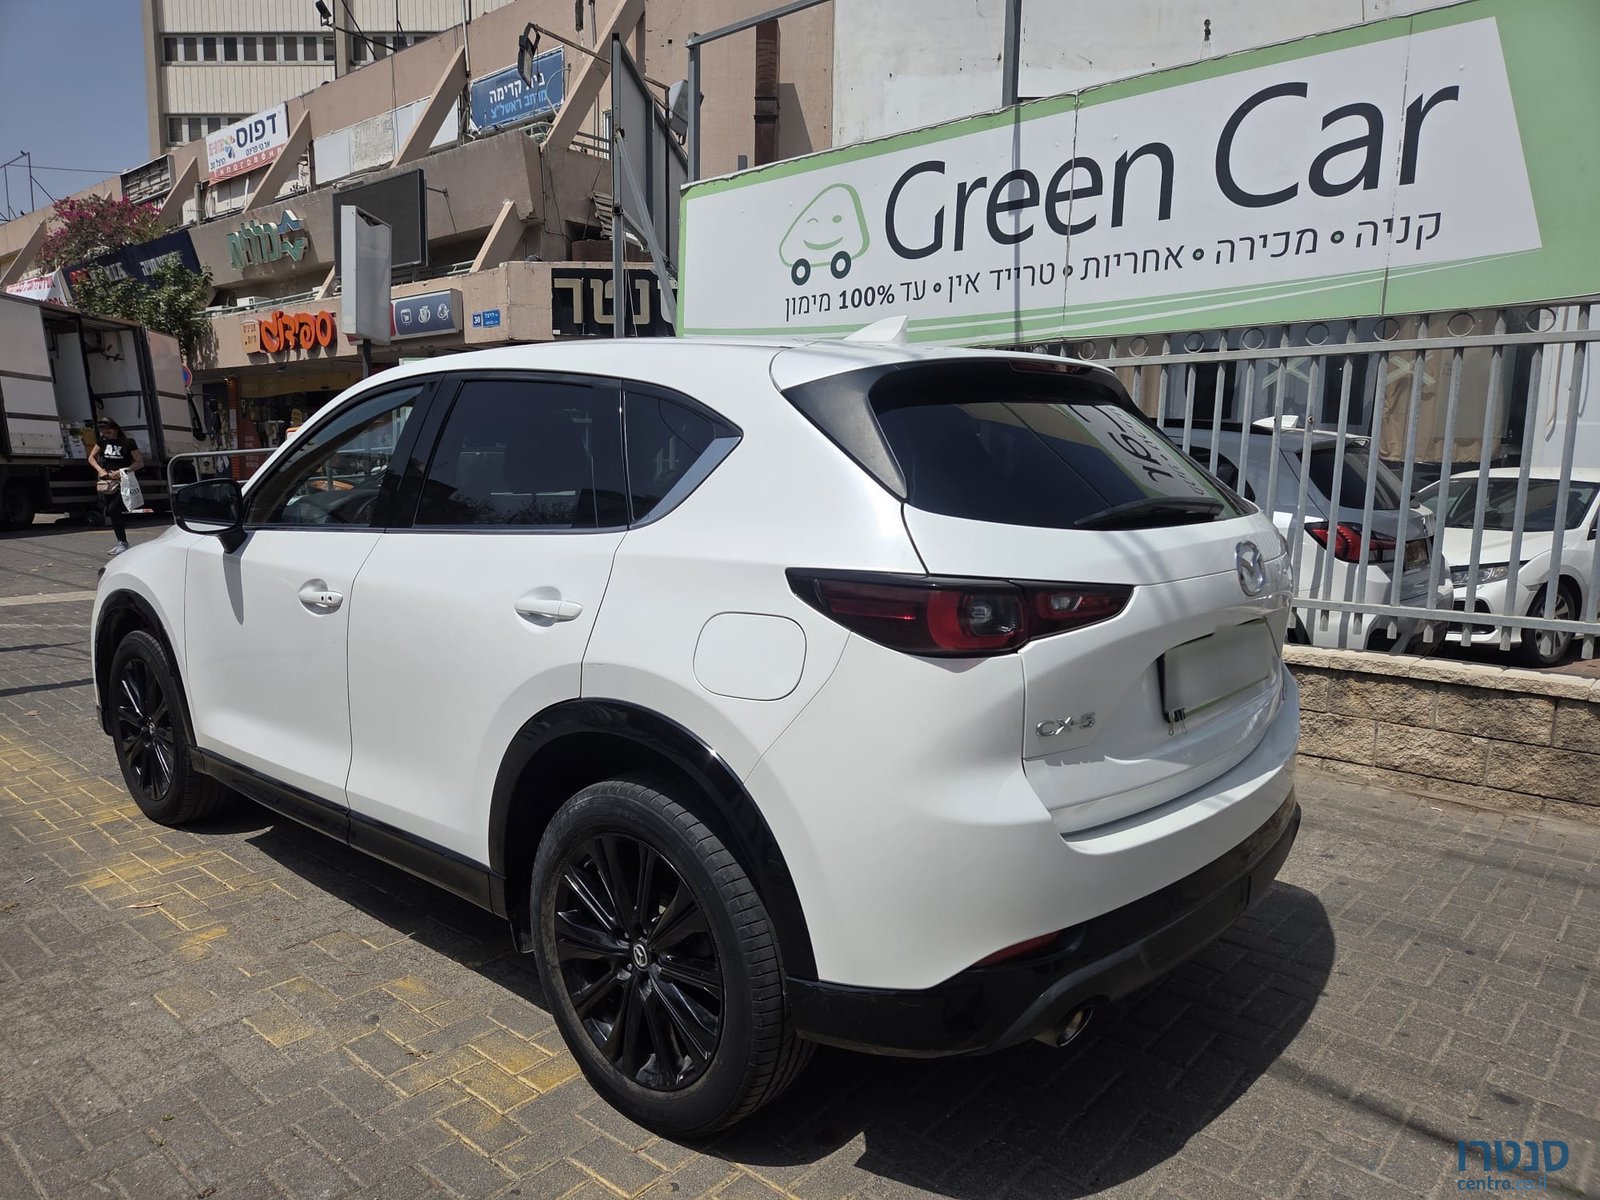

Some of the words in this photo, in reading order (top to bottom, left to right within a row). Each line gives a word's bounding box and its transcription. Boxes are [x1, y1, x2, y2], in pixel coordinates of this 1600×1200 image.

[489, 80, 522, 104] קדימה
[236, 114, 277, 148] דפוס
[885, 142, 1175, 259] Green
[1215, 82, 1459, 208] Car
[1215, 228, 1318, 264] מכירה
[1356, 212, 1441, 250] קניה
[989, 262, 1056, 291] טרייד
[1080, 245, 1185, 281] אחריות
[838, 284, 896, 310] 100%
[900, 279, 927, 302] עד
[948, 272, 981, 303] אין
[473, 315, 481, 325] 30
[785, 292, 831, 323] מימון
[104, 444, 122, 456] AX
[1035, 711, 1096, 738] CX-5
